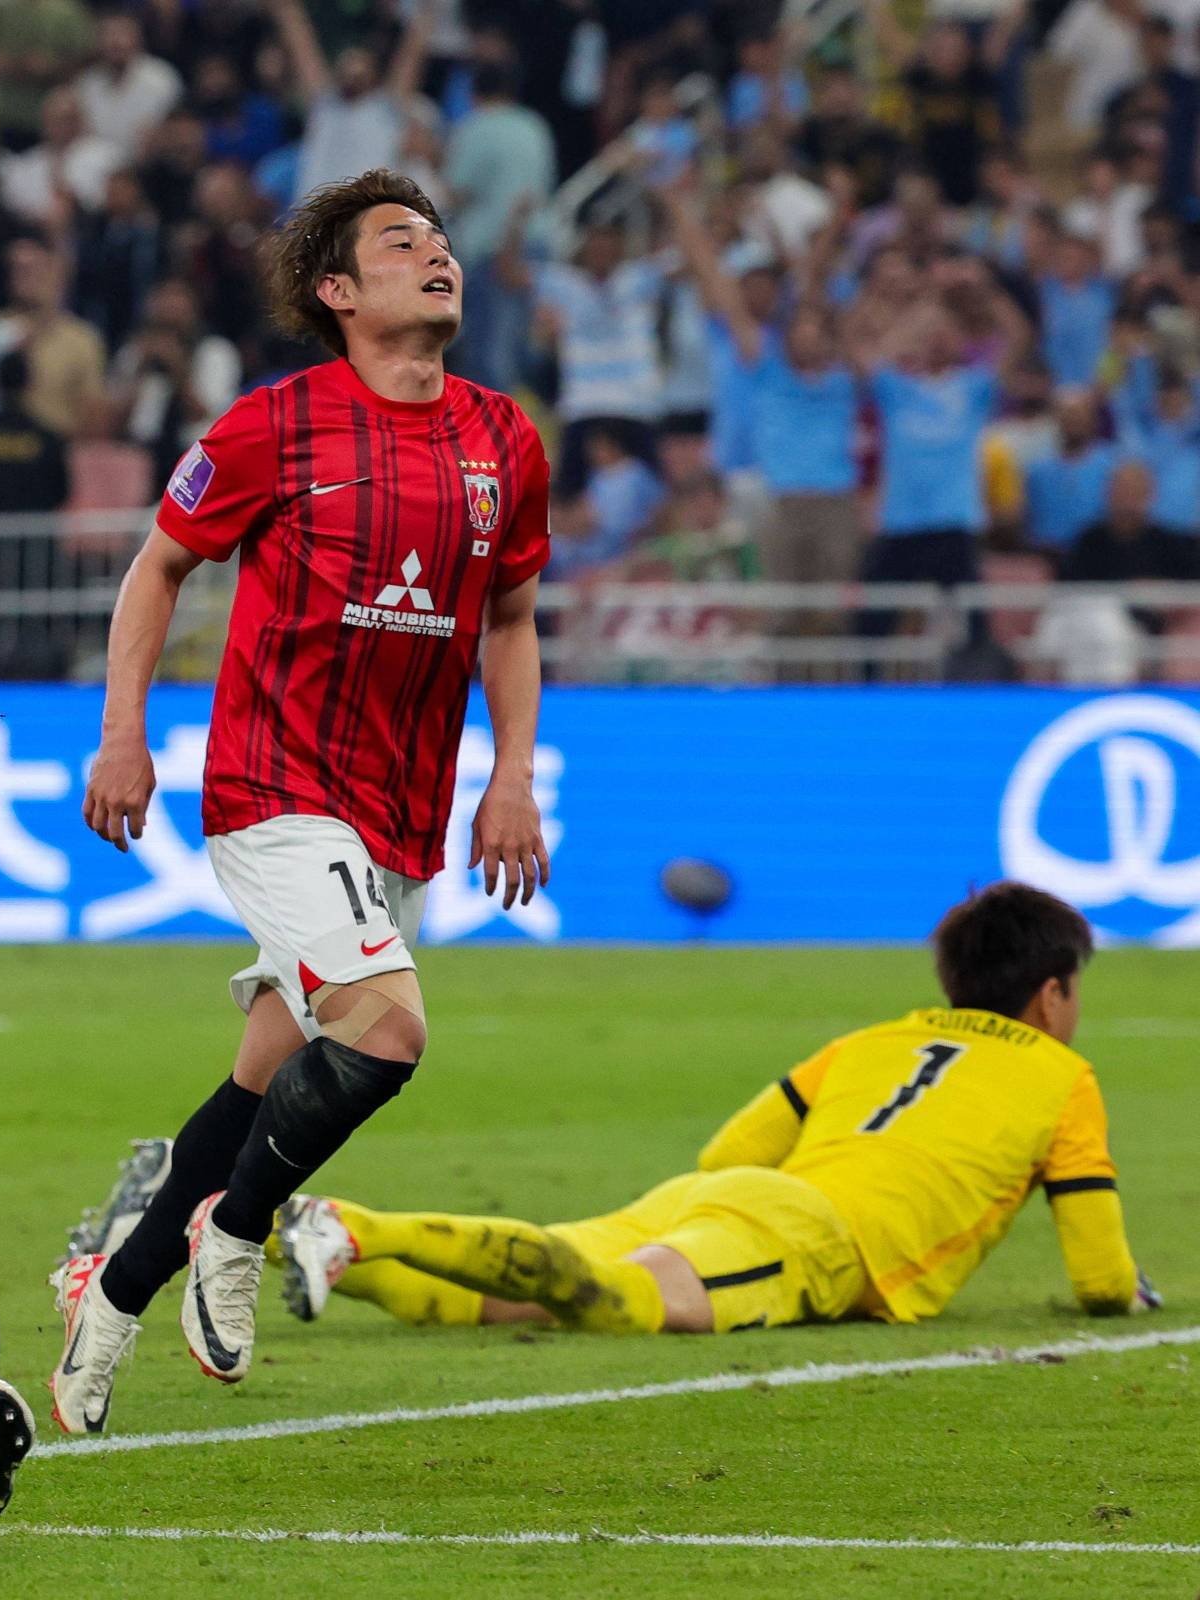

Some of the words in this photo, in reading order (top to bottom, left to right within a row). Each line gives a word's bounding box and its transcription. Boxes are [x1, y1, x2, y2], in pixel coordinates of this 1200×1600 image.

[341, 615, 384, 630] HEAVY
[385, 623, 454, 638] INDUSTRIES
[342, 602, 456, 630] MITSUBISHI
[857, 1041, 966, 1134] 1
